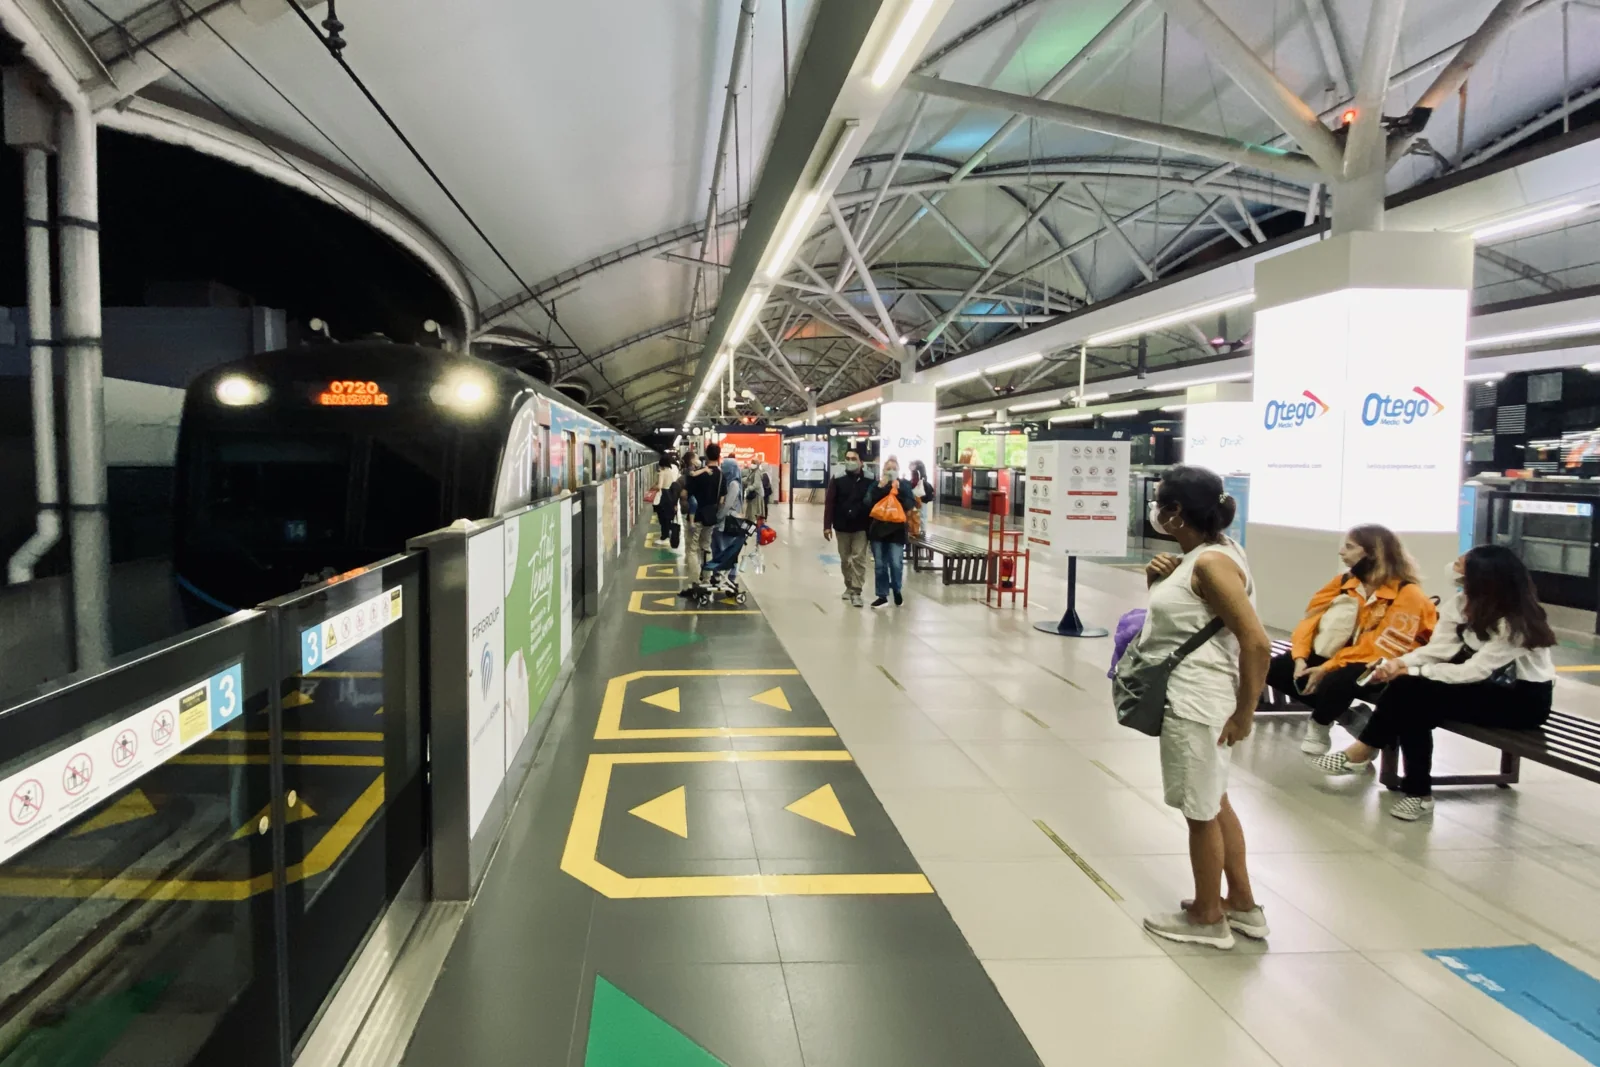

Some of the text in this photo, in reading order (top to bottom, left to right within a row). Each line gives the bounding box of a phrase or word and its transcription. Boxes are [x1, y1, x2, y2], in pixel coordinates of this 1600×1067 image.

[330, 380, 379, 394] 0720
[1264, 400, 1317, 430] Otego
[1361, 393, 1429, 426] Otego
[472, 606, 500, 642] FIFGROUP
[307, 631, 319, 666] 3
[219, 674, 236, 718] 3
